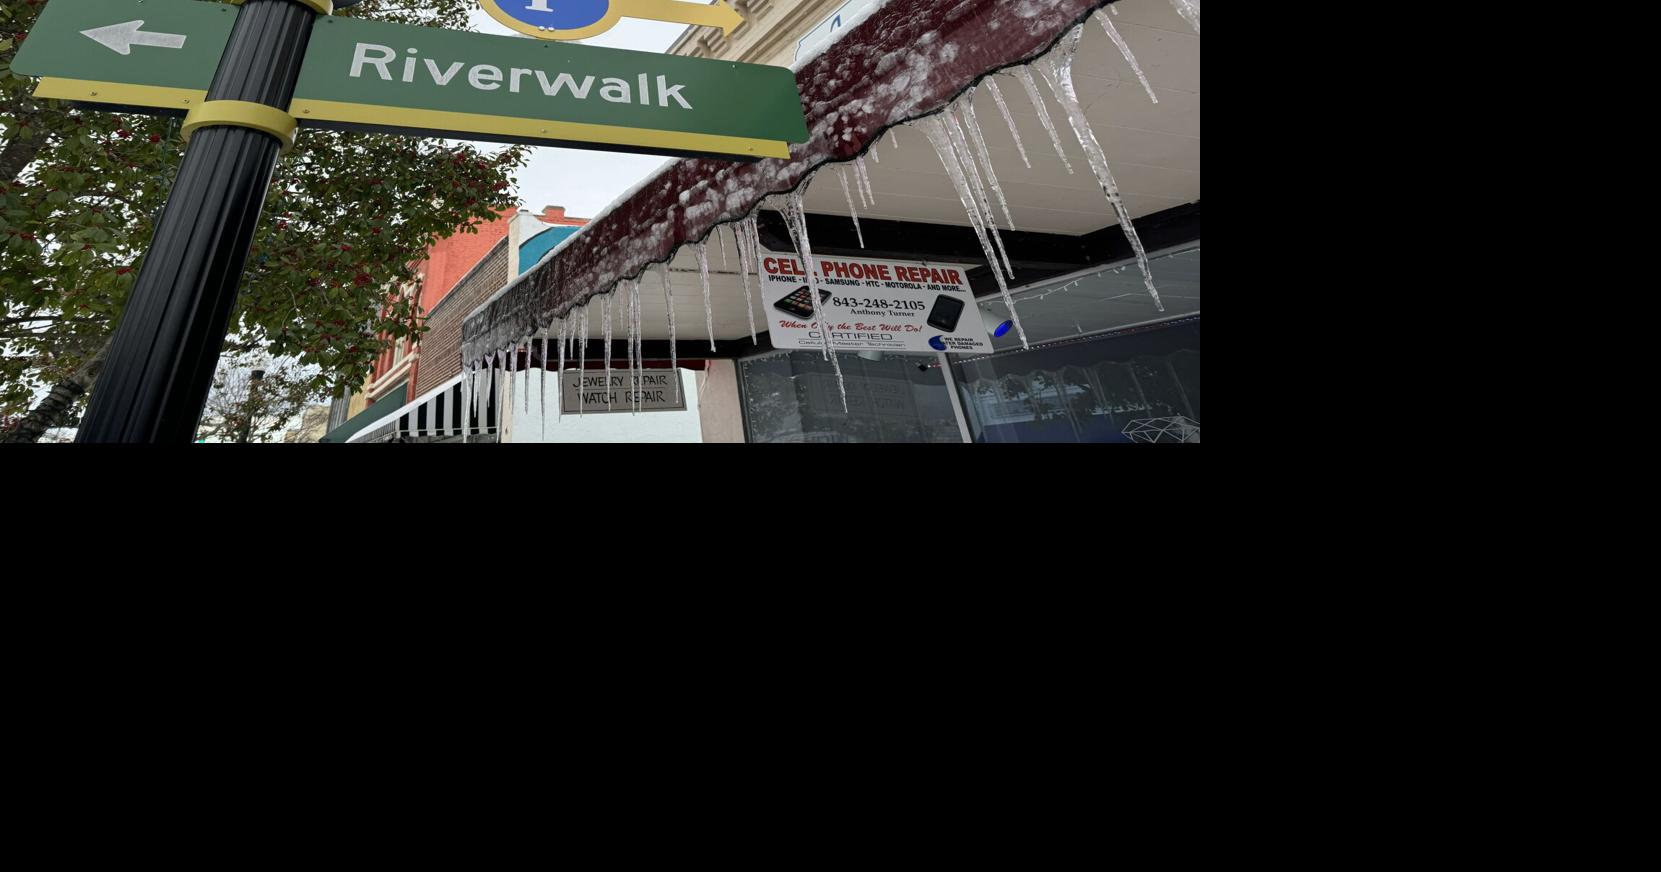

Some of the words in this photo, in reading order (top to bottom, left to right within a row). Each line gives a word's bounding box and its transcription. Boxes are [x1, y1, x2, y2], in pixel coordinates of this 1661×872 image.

[348, 42, 693, 110] Riverwalk
[763, 256, 816, 276] CEL
[820, 260, 892, 280] PHONE
[893, 265, 963, 285] REPAIR
[768, 274, 797, 283] IPHONE
[825, 278, 860, 286] SAMSUNG
[865, 280, 880, 288] HTC
[884, 281, 923, 290] MOTOROLA
[832, 296, 926, 311] 843-248-2105
[850, 308, 886, 317] Anthony
[779, 320, 807, 329] When
[837, 322, 852, 330] the
[855, 322, 876, 331] Best
[879, 323, 902, 332] Will
[904, 324, 923, 333] Do!
[808, 331, 893, 340] CRTIFIED
[572, 375, 624, 388] JEWELRY
[577, 391, 617, 404] WATCH
[625, 390, 666, 404] REPAIR
